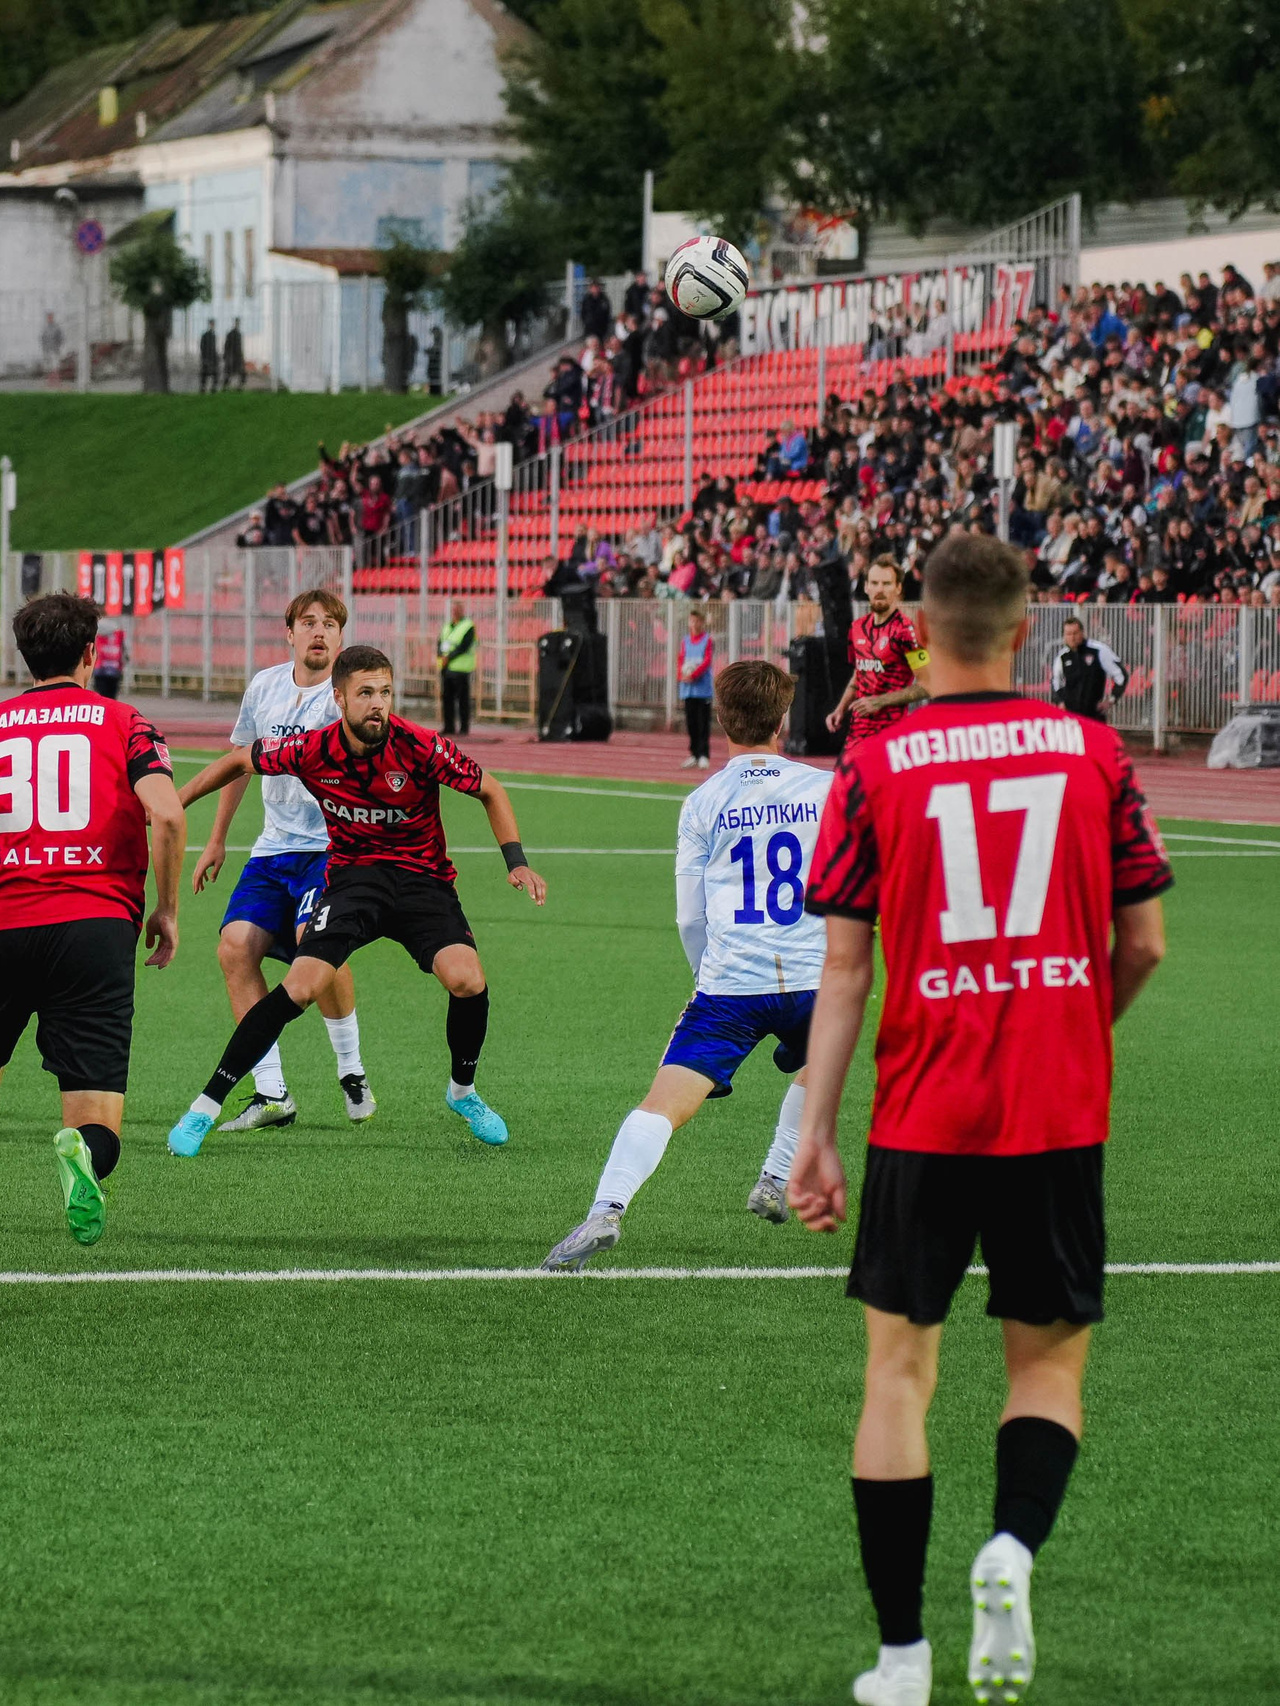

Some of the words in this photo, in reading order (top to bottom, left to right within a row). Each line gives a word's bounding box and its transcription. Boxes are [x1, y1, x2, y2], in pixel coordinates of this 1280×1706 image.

[886, 717, 1086, 774] КОЗЛОВСКИЙ
[322, 798, 410, 824] GARPIX
[718, 802, 818, 833] АБДУЛКИН
[730, 831, 805, 926] 18
[925, 771, 1068, 944] 17
[314, 905, 331, 932] 3
[919, 956, 1090, 999] GALTEX
